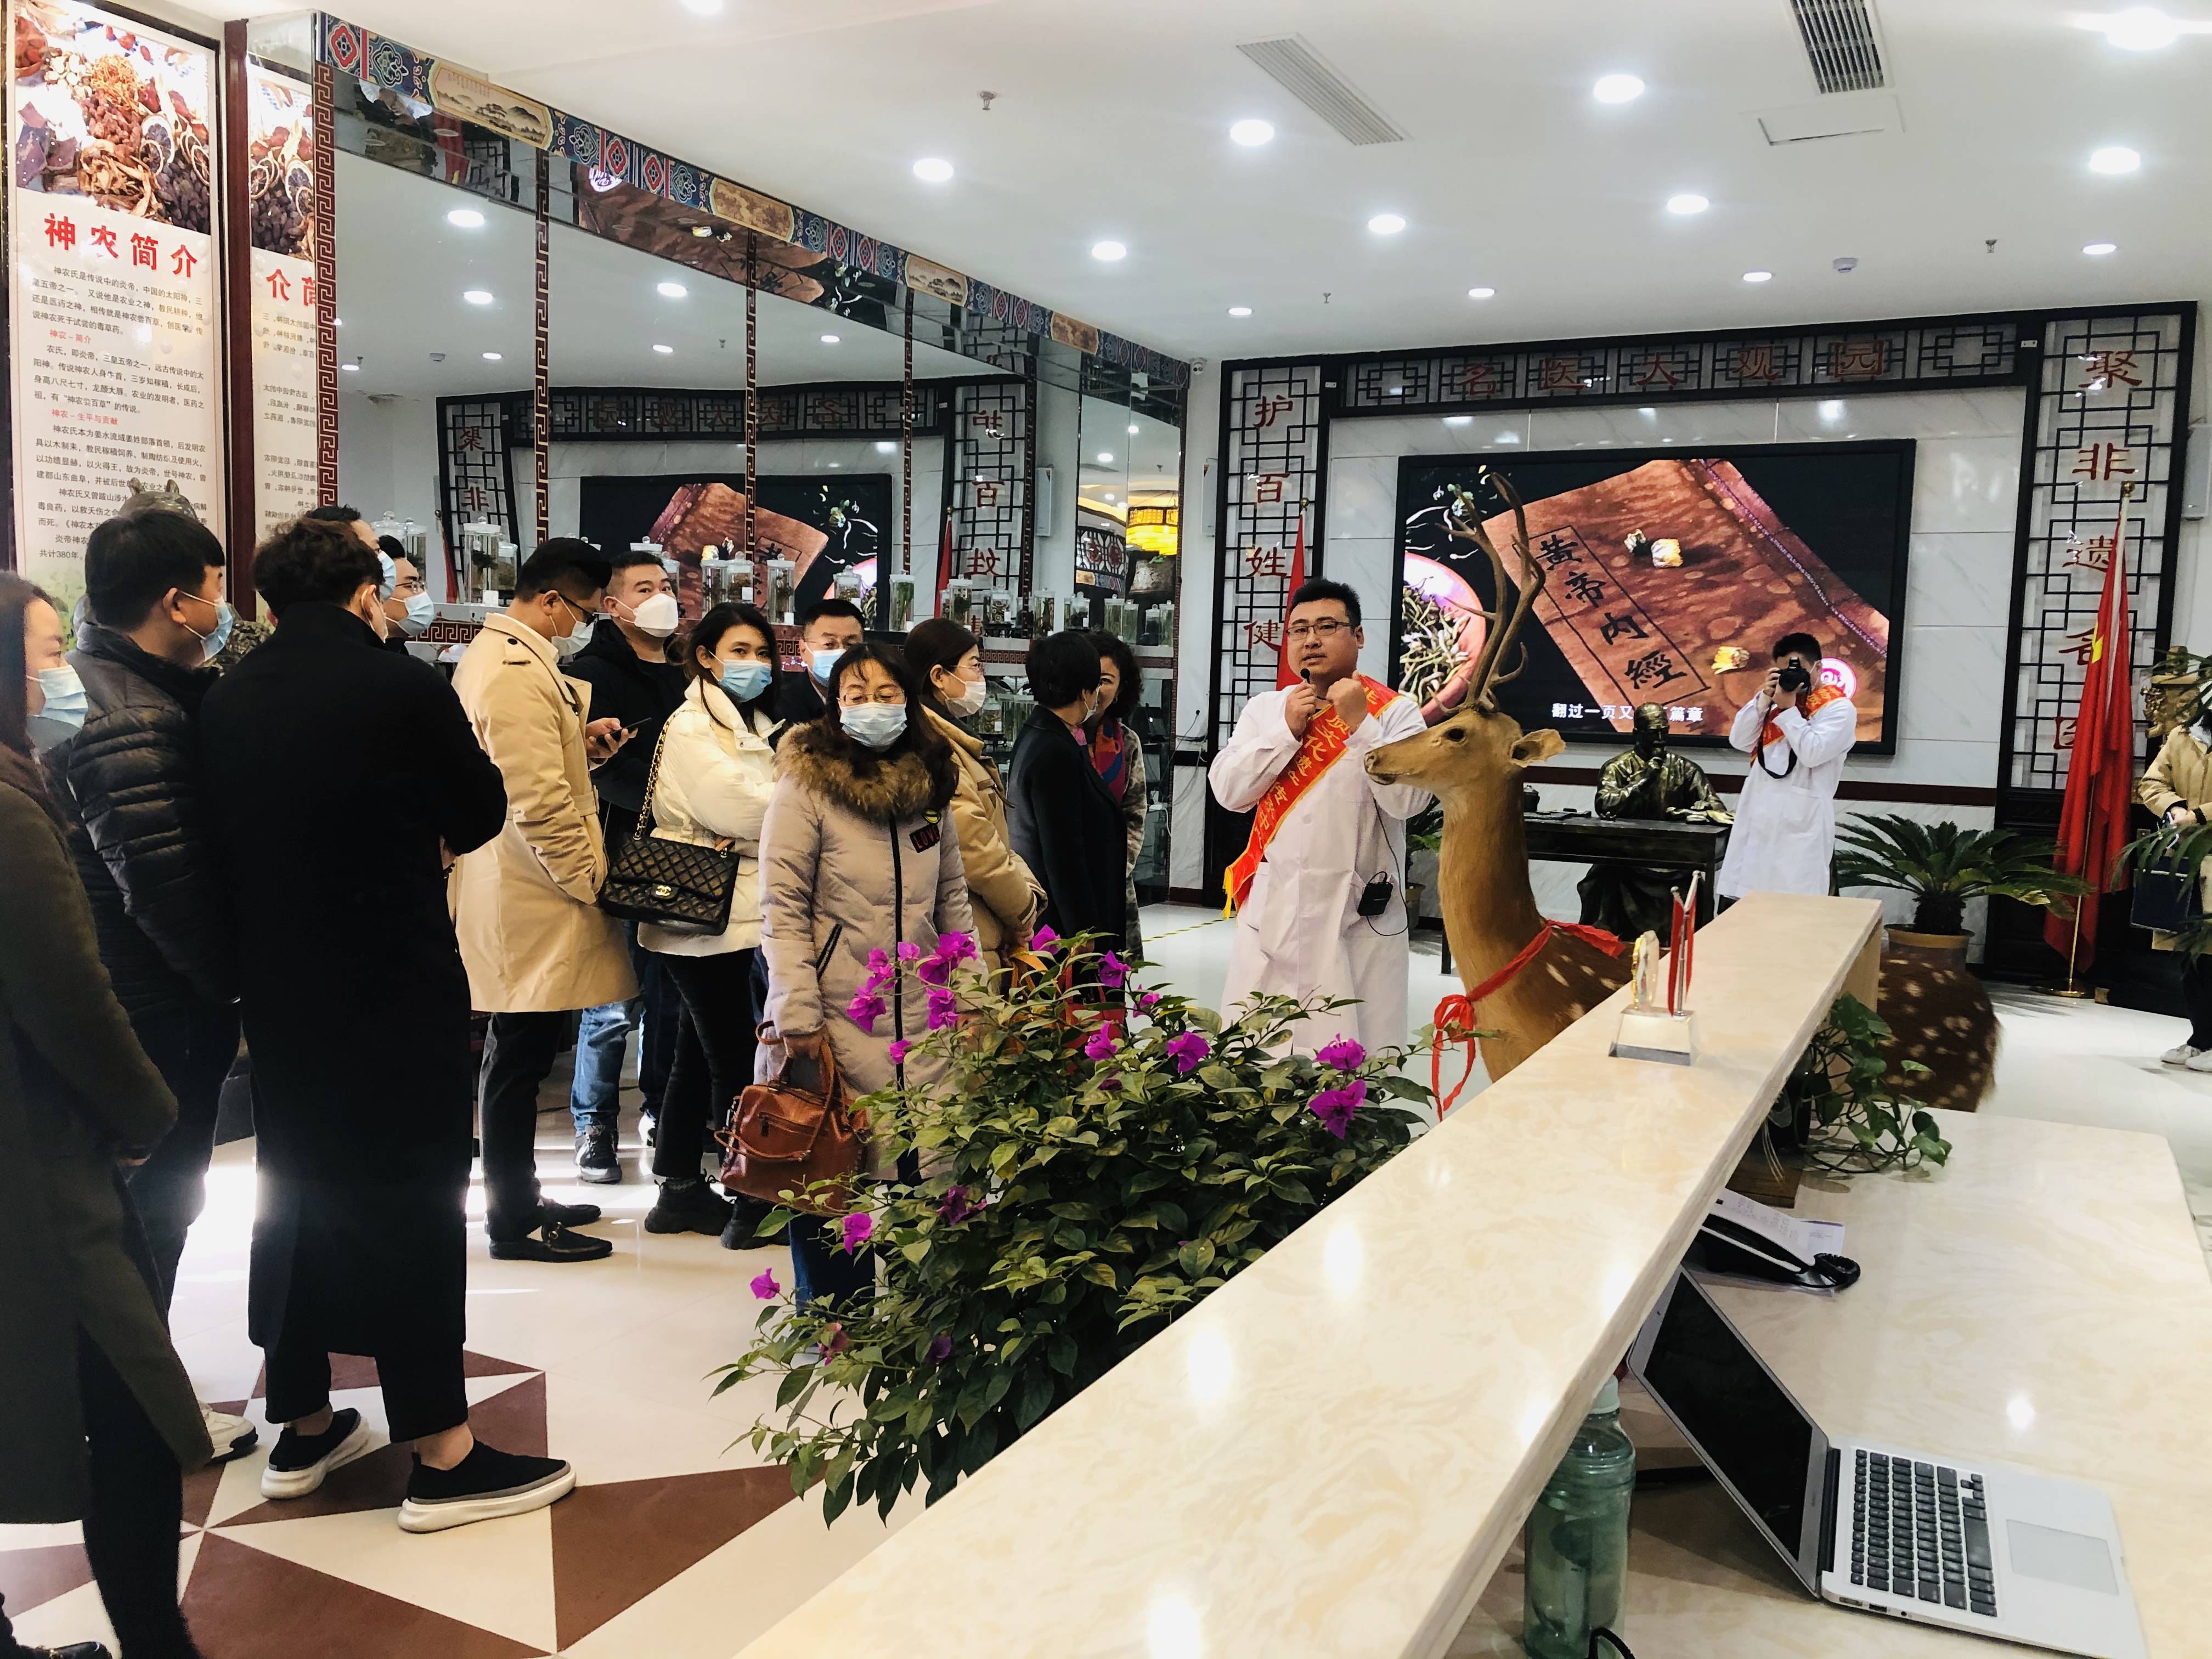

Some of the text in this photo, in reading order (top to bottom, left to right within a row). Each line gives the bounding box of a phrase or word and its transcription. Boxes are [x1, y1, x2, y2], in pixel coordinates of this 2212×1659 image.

[44, 213, 198, 278] 神农简介
[1457, 340, 1886, 396] 名医大观园
[1243, 394, 1293, 652] 护百姓健
[1551, 702, 1703, 722] 翻过一页又篇章
